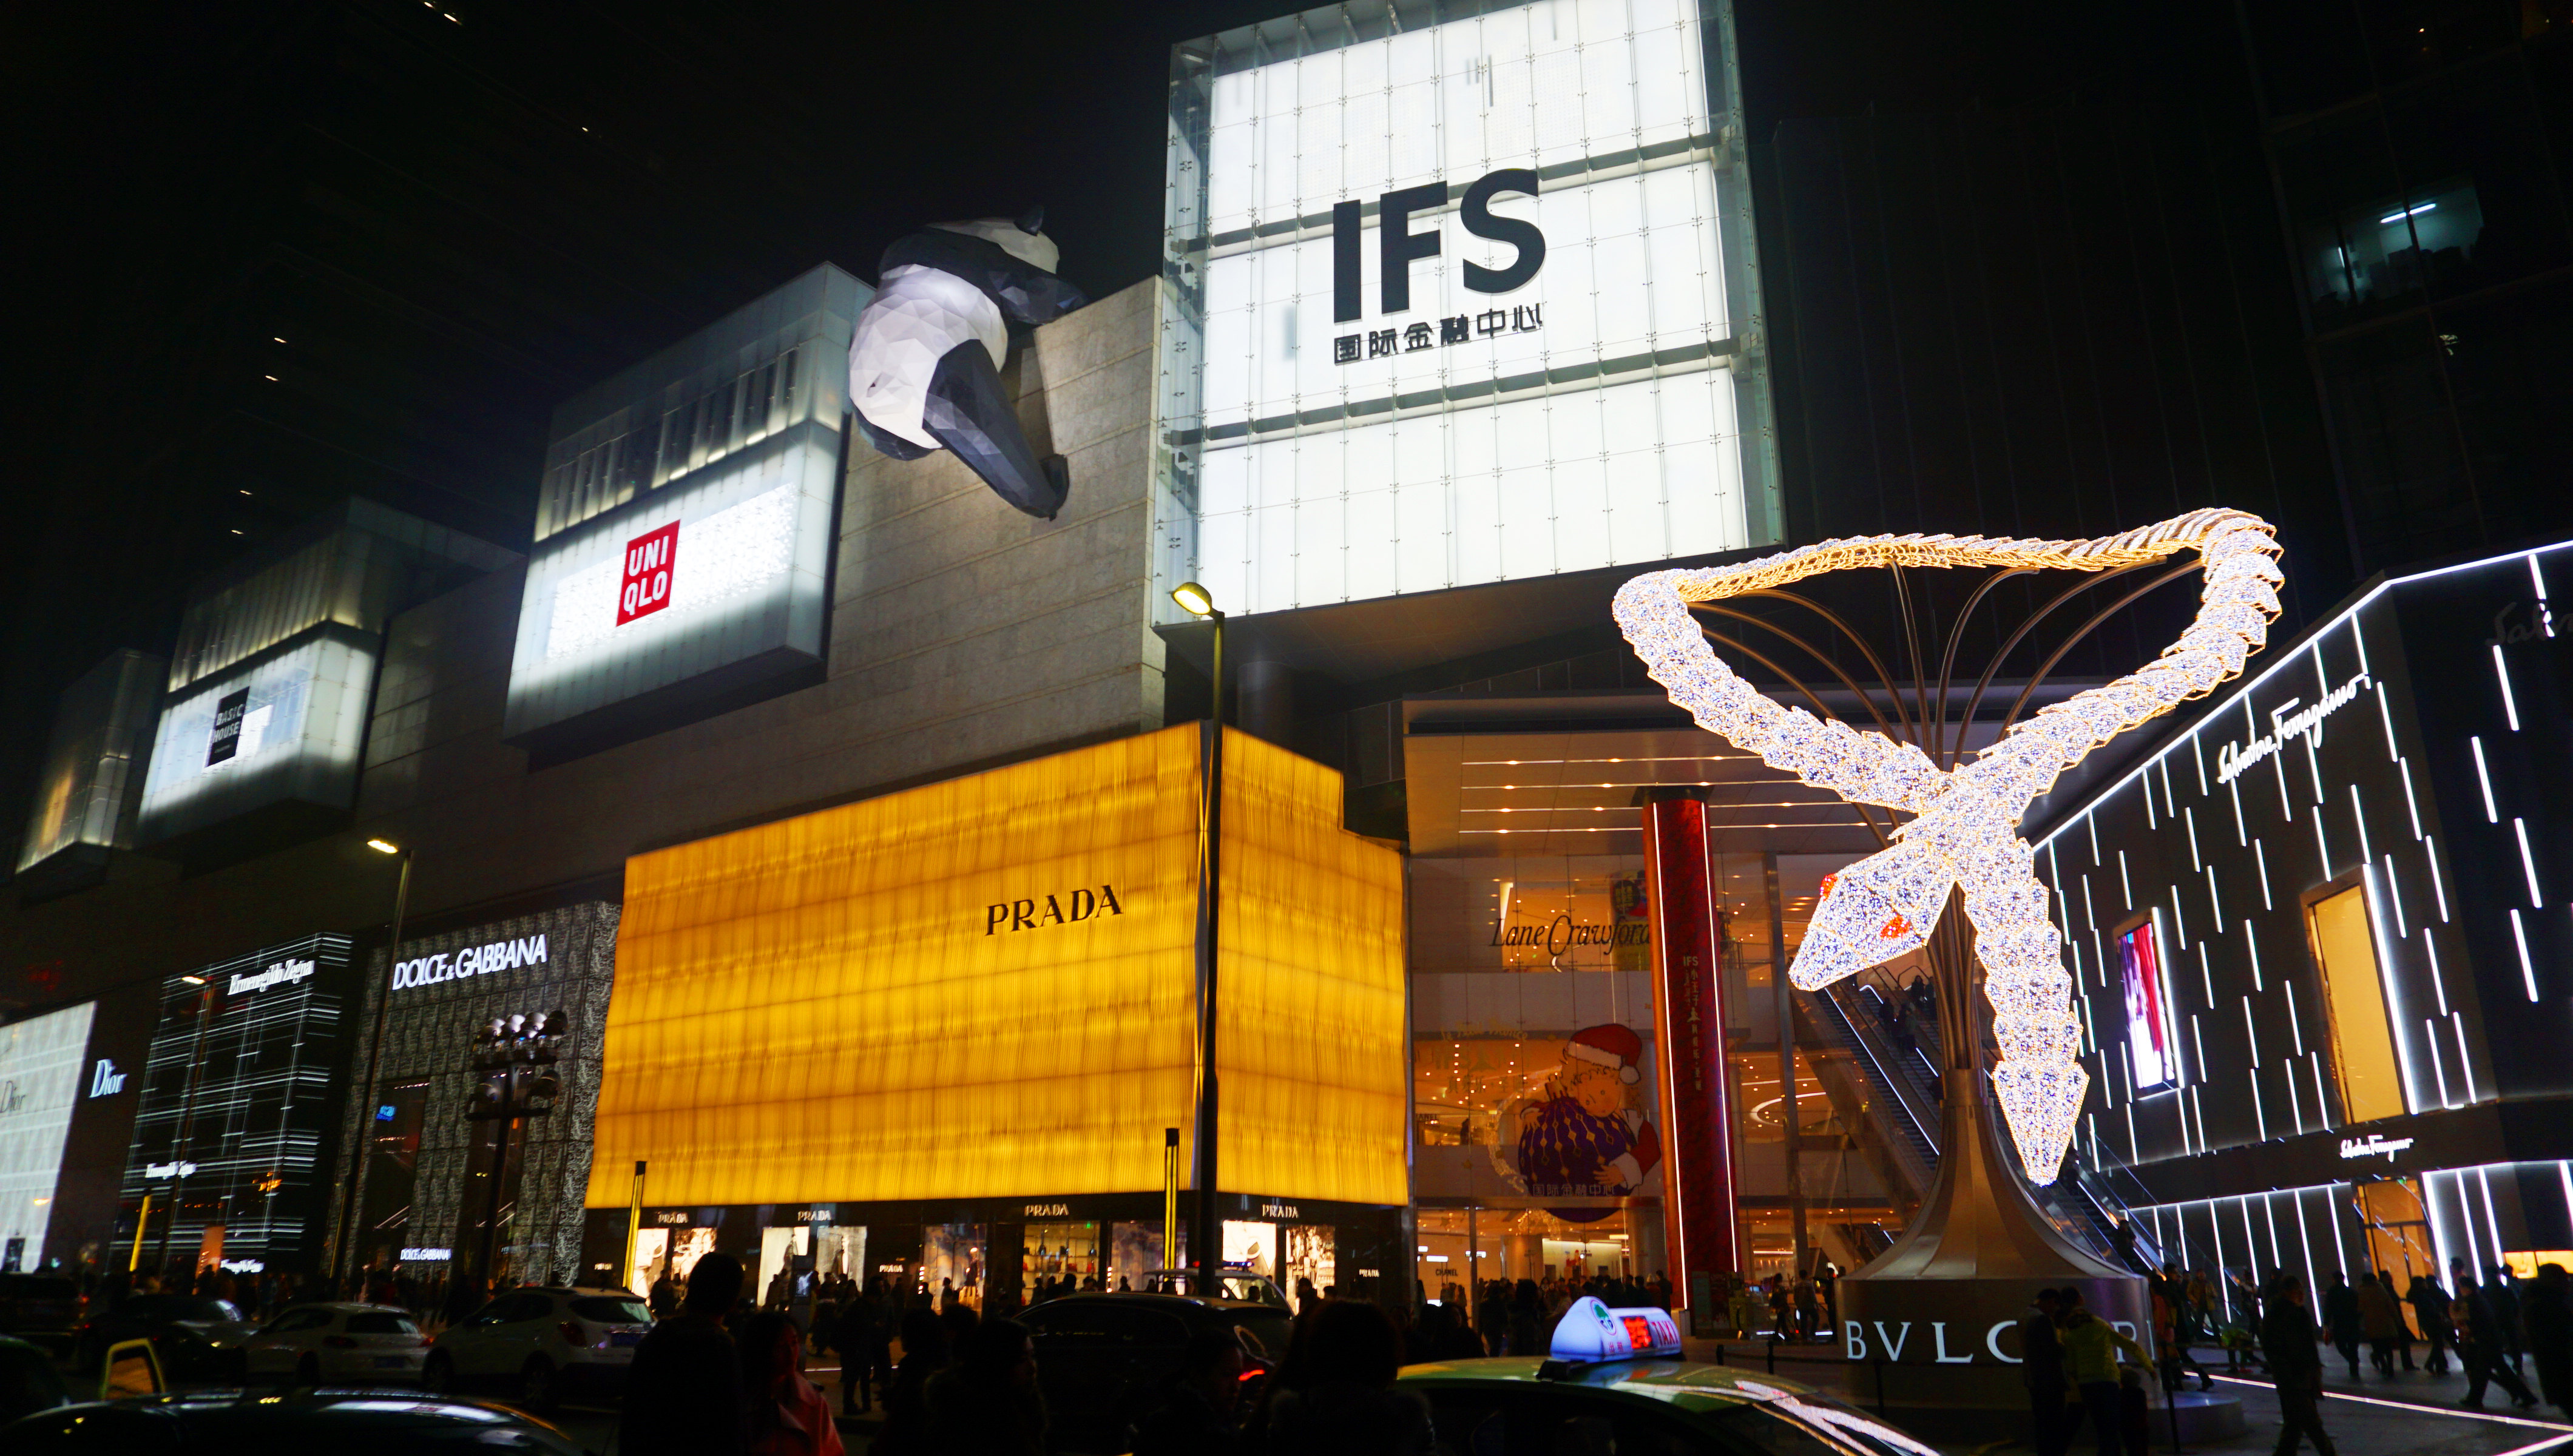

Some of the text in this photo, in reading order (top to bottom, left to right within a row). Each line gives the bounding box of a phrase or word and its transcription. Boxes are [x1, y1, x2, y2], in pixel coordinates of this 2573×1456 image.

[1333, 168, 1546, 324] IFS
[1334, 303, 1543, 365] 国际金融中心
[628, 535, 669, 576] UNI
[623, 571, 668, 616] QLO
[216, 703, 245, 726] BASIC
[2271, 672, 2365, 750] Ferragamo
[212, 721, 240, 743] HOUSE
[985, 885, 1123, 936] PRADA
[1489, 918, 1546, 947] Lane
[282, 959, 315, 984] Zegna
[392, 934, 547, 990] DOLCE&GABBANA
[1683, 956, 1699, 966] IFS
[89, 1059, 127, 1097] Dior
[0, 1080, 25, 1113] Dior
[657, 1212, 689, 1223] PRADA
[797, 1210, 832, 1221] PRADA
[1024, 1204, 1069, 1216] PRADA
[1262, 1204, 1299, 1218] PRADA
[1359, 1269, 1380, 1278] PRADA
[1651, 1321, 1679, 1345] TAXI
